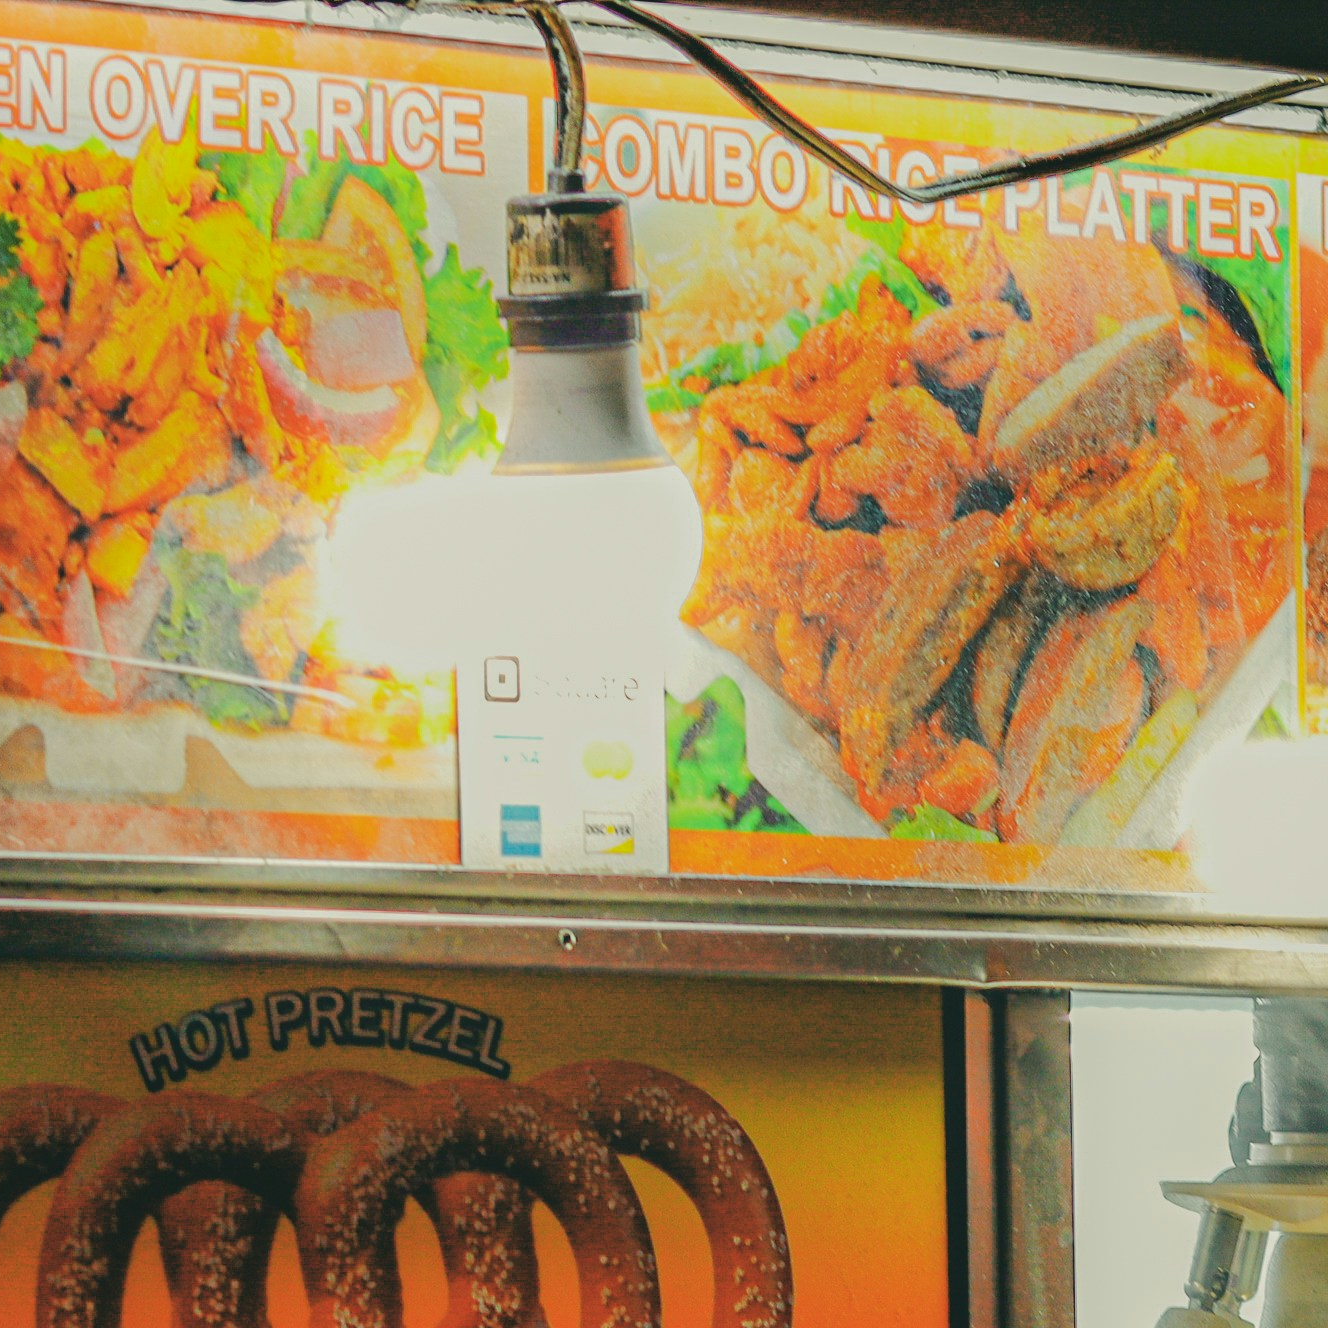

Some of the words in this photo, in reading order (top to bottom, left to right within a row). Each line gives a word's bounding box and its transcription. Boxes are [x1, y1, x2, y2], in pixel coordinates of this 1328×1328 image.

[90, 54, 300, 157] OVER
[318, 78, 485, 176] RICE
[1003, 167, 1283, 263] PLATTER
[130, 998, 255, 1093] HOT
[265, 987, 512, 1081] PRETZEL
